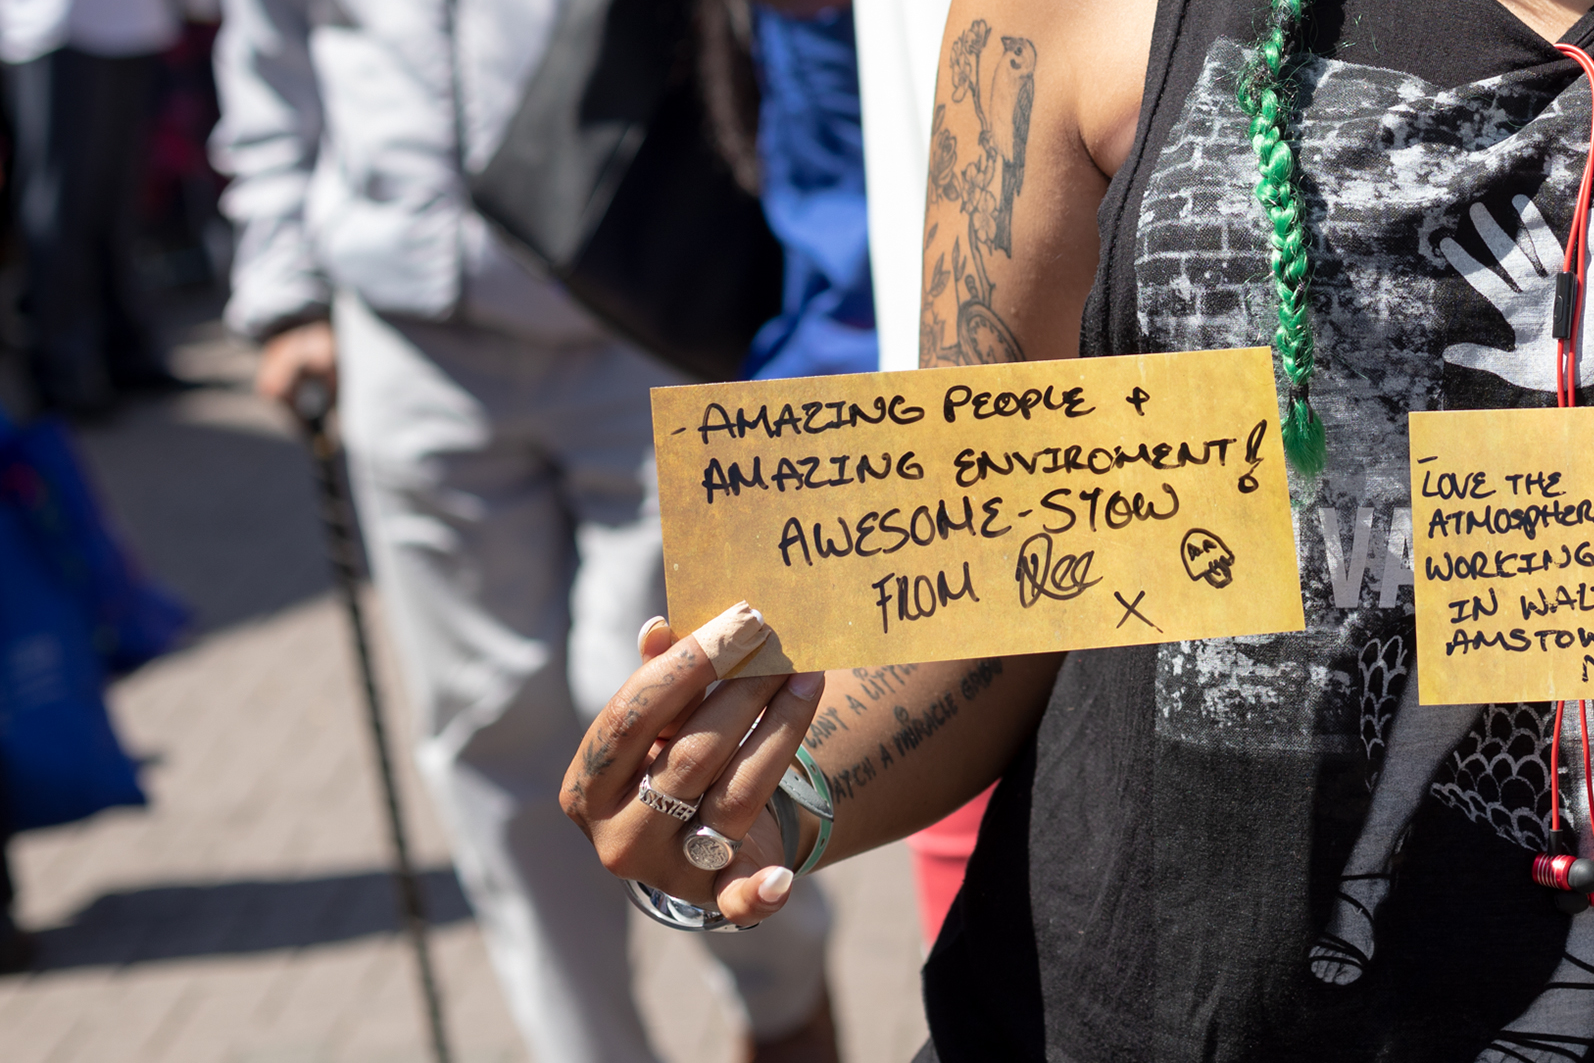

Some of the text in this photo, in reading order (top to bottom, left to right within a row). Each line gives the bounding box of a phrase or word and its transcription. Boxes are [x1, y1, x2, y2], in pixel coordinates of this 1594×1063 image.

[943, 384, 1096, 424] PEOPLE
[701, 451, 924, 505] AMAZING
[1421, 470, 1497, 500] LOVE
[1504, 470, 1567, 499] THE
[871, 562, 980, 634] FROM
[1448, 587, 1498, 624] IN
[821, 755, 877, 805] ATCH
